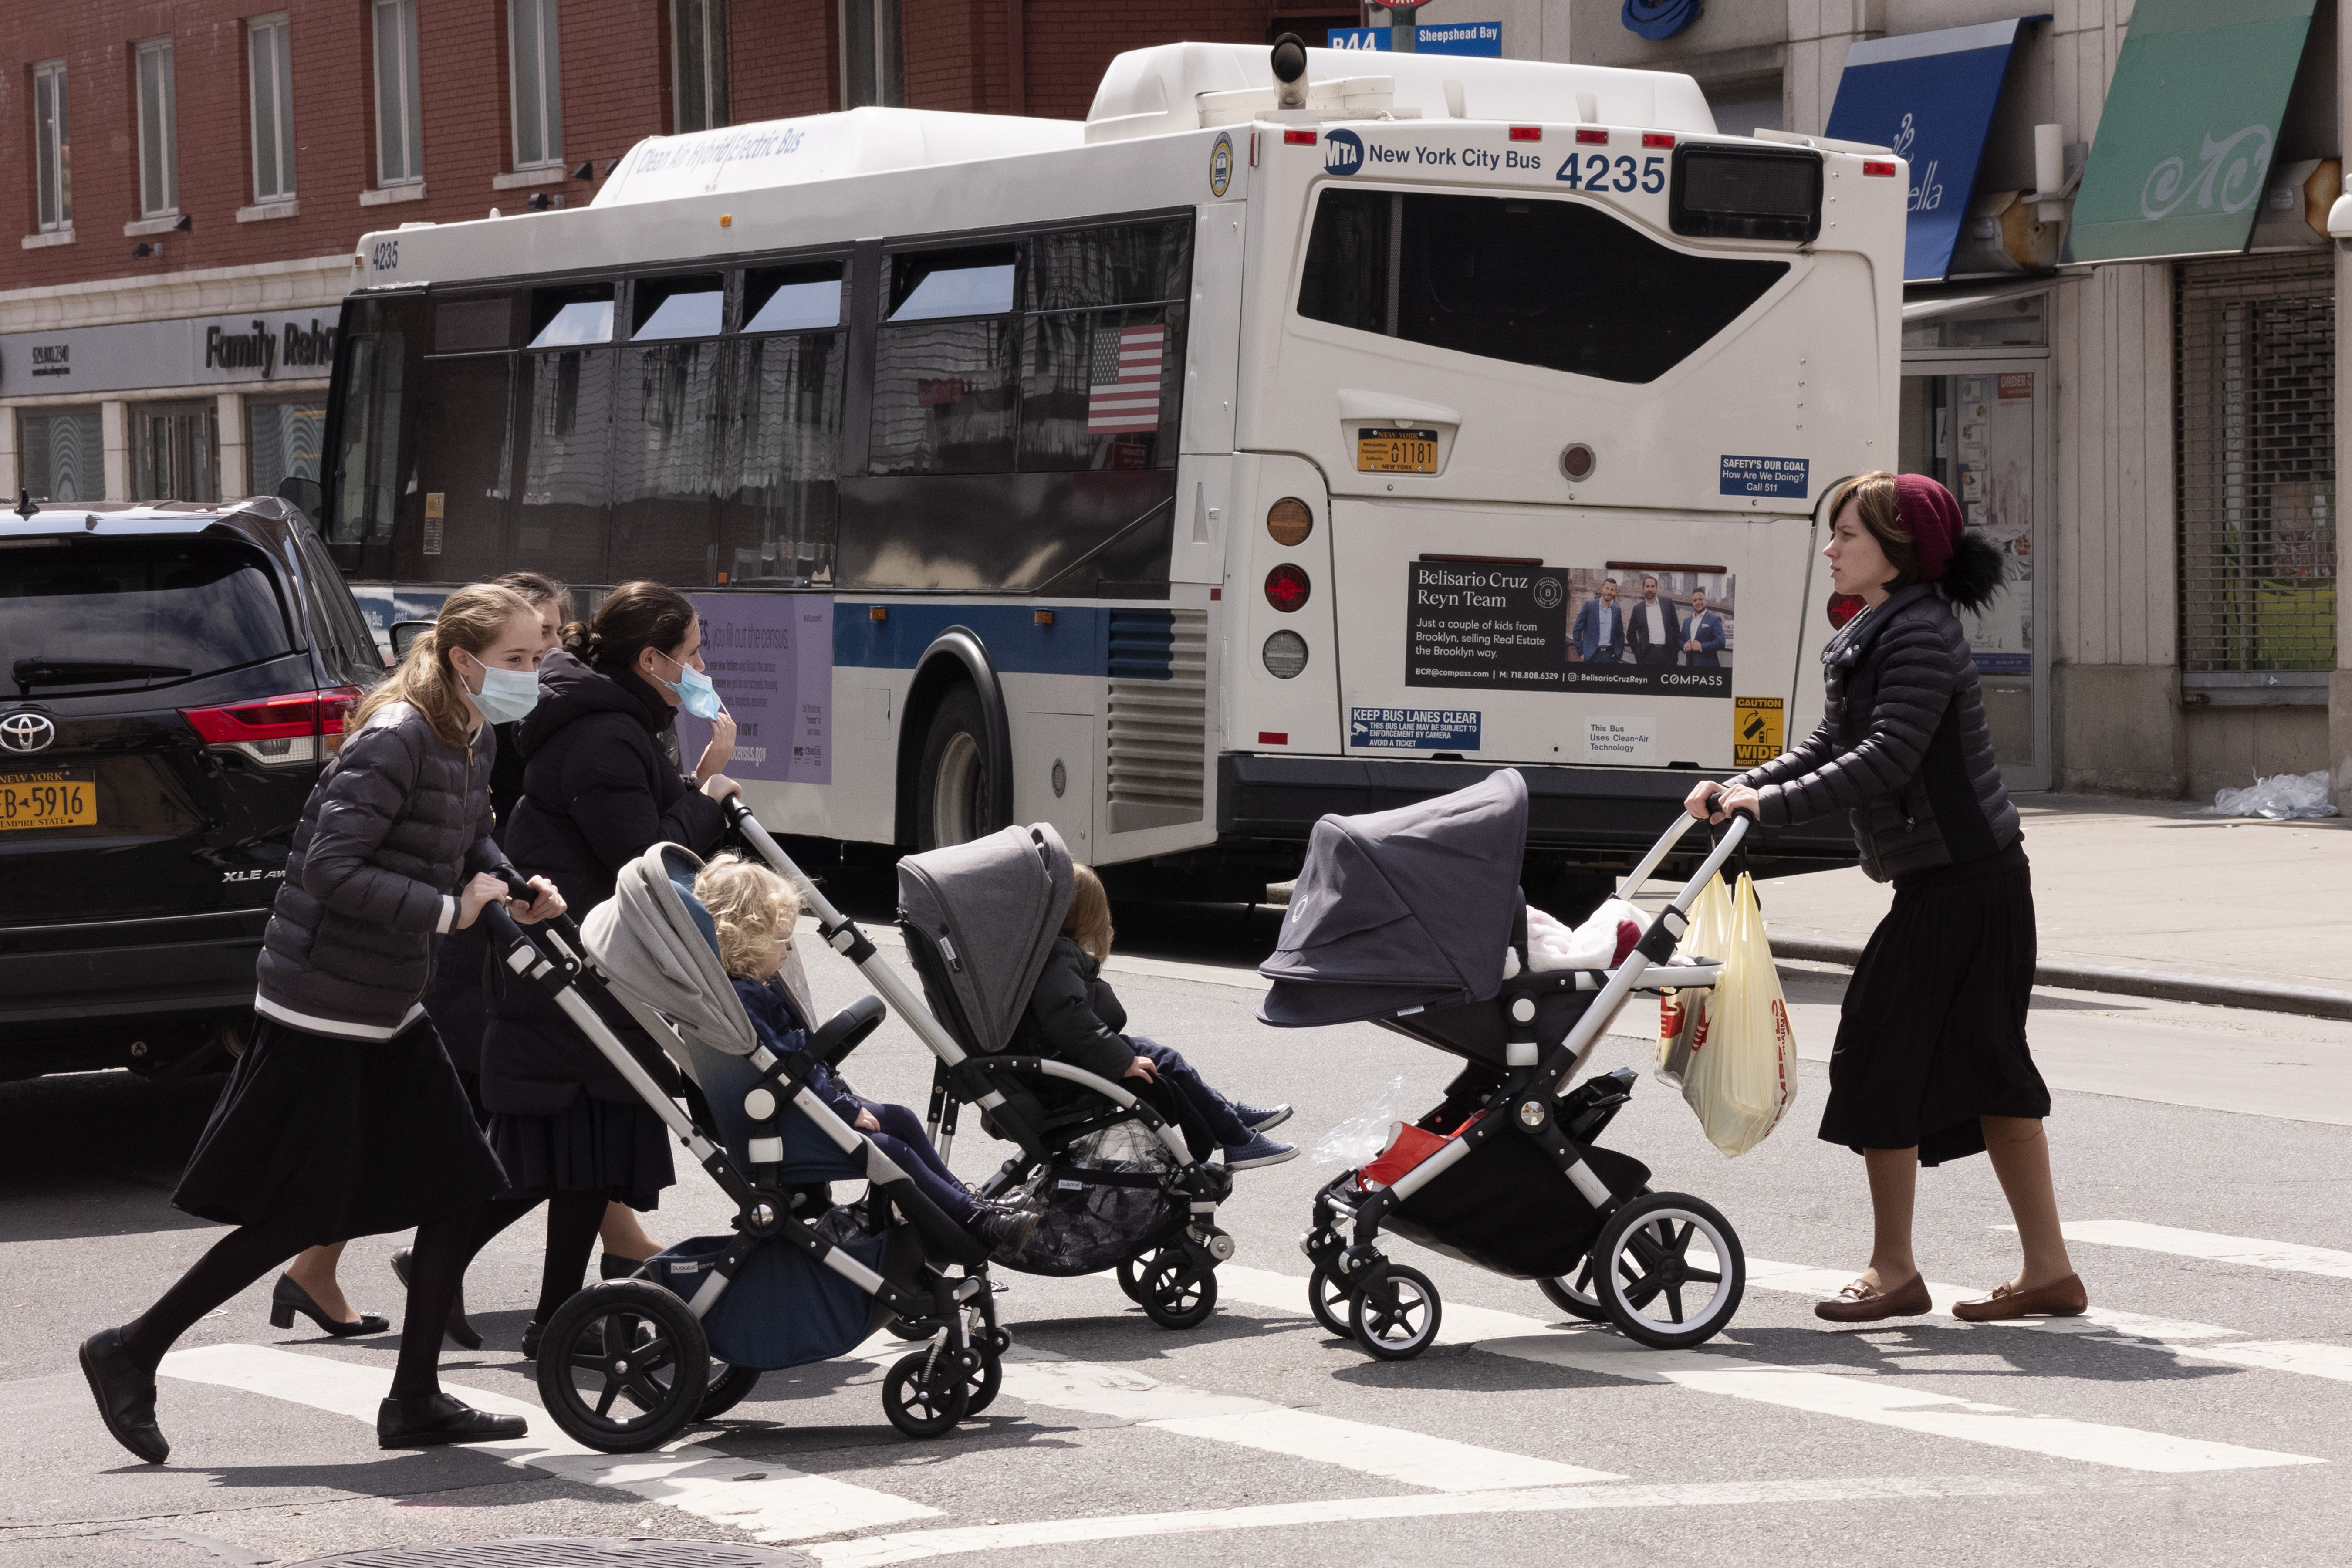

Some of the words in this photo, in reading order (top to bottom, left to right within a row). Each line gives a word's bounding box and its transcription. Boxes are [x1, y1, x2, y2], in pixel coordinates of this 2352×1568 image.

[1419, 27, 1477, 43] Sheepshead
[1479, 27, 1497, 41] Bay
[636, 147, 671, 174] Clean
[666, 142, 690, 169] Air
[686, 136, 735, 172] Hybrid
[726, 130, 778, 162] Electric
[775, 128, 805, 155] Bus
[1325, 138, 1358, 168] MTA
[1369, 144, 1410, 163] New
[1415, 146, 1456, 165] York
[1462, 148, 1500, 170] City
[1506, 150, 1541, 169] Bus
[1556, 152, 1665, 194] 4235
[373, 240, 398, 270] 4235
[206, 319, 276, 378] Family
[2001, 375, 2025, 388] ORDER
[1402, 443, 1431, 463] 1181
[1723, 459, 1762, 469] SAFETY'S
[1764, 460, 1781, 470] OUR
[1784, 461, 1805, 471] GOAL
[1723, 470, 1741, 479] How
[1743, 471, 1757, 480] Are
[1760, 472, 1772, 480] We
[1775, 473, 1804, 483] Doing?
[1747, 483, 1762, 491] Call
[1418, 569, 1486, 587] Belisario
[1489, 572, 1528, 588] Cruz
[1418, 589, 1459, 608] Reyn
[1463, 591, 1507, 608] Team
[372, 611, 383, 627] Bus
[1416, 618, 1436, 628] Just
[1447, 620, 1480, 631] couple
[1482, 620, 1492, 629] of
[1494, 621, 1513, 630] kids
[1515, 621, 1538, 631] from
[713, 628, 725, 652] you
[735, 627, 747, 648] out
[748, 623, 760, 649] the
[762, 628, 789, 649] census.
[1416, 632, 1459, 644] Brooklyn,
[1461, 634, 1490, 645] selling
[1494, 635, 1514, 644] Real
[1517, 635, 1546, 645] Estate
[1416, 645, 1431, 655] the
[1434, 646, 1474, 658] Brooklyn
[1477, 649, 1498, 659] way.
[1416, 668, 1489, 677] BCR@compass.com
[1510, 672, 1558, 680] 718.808.6329
[1581, 674, 1648, 685] BelisarioCruzReyn
[1660, 674, 1722, 686] COMPASS
[1738, 699, 1781, 707] CAUTION
[1353, 709, 1380, 720] KEEP
[1382, 710, 1404, 722] BUS
[1406, 711, 1440, 723] LANES
[1443, 712, 1477, 724] CLEAR
[794, 746, 803, 756] NYC
[1590, 743, 1634, 753] Technology
[1737, 745, 1780, 759] WIDE
[0, 774, 27, 784] NEW
[30, 772, 63, 781] YORK
[0, 789, 17, 819] B
[32, 786, 83, 817] 5916
[38, 817, 66, 825] STATE
[221, 869, 262, 883] XLE
